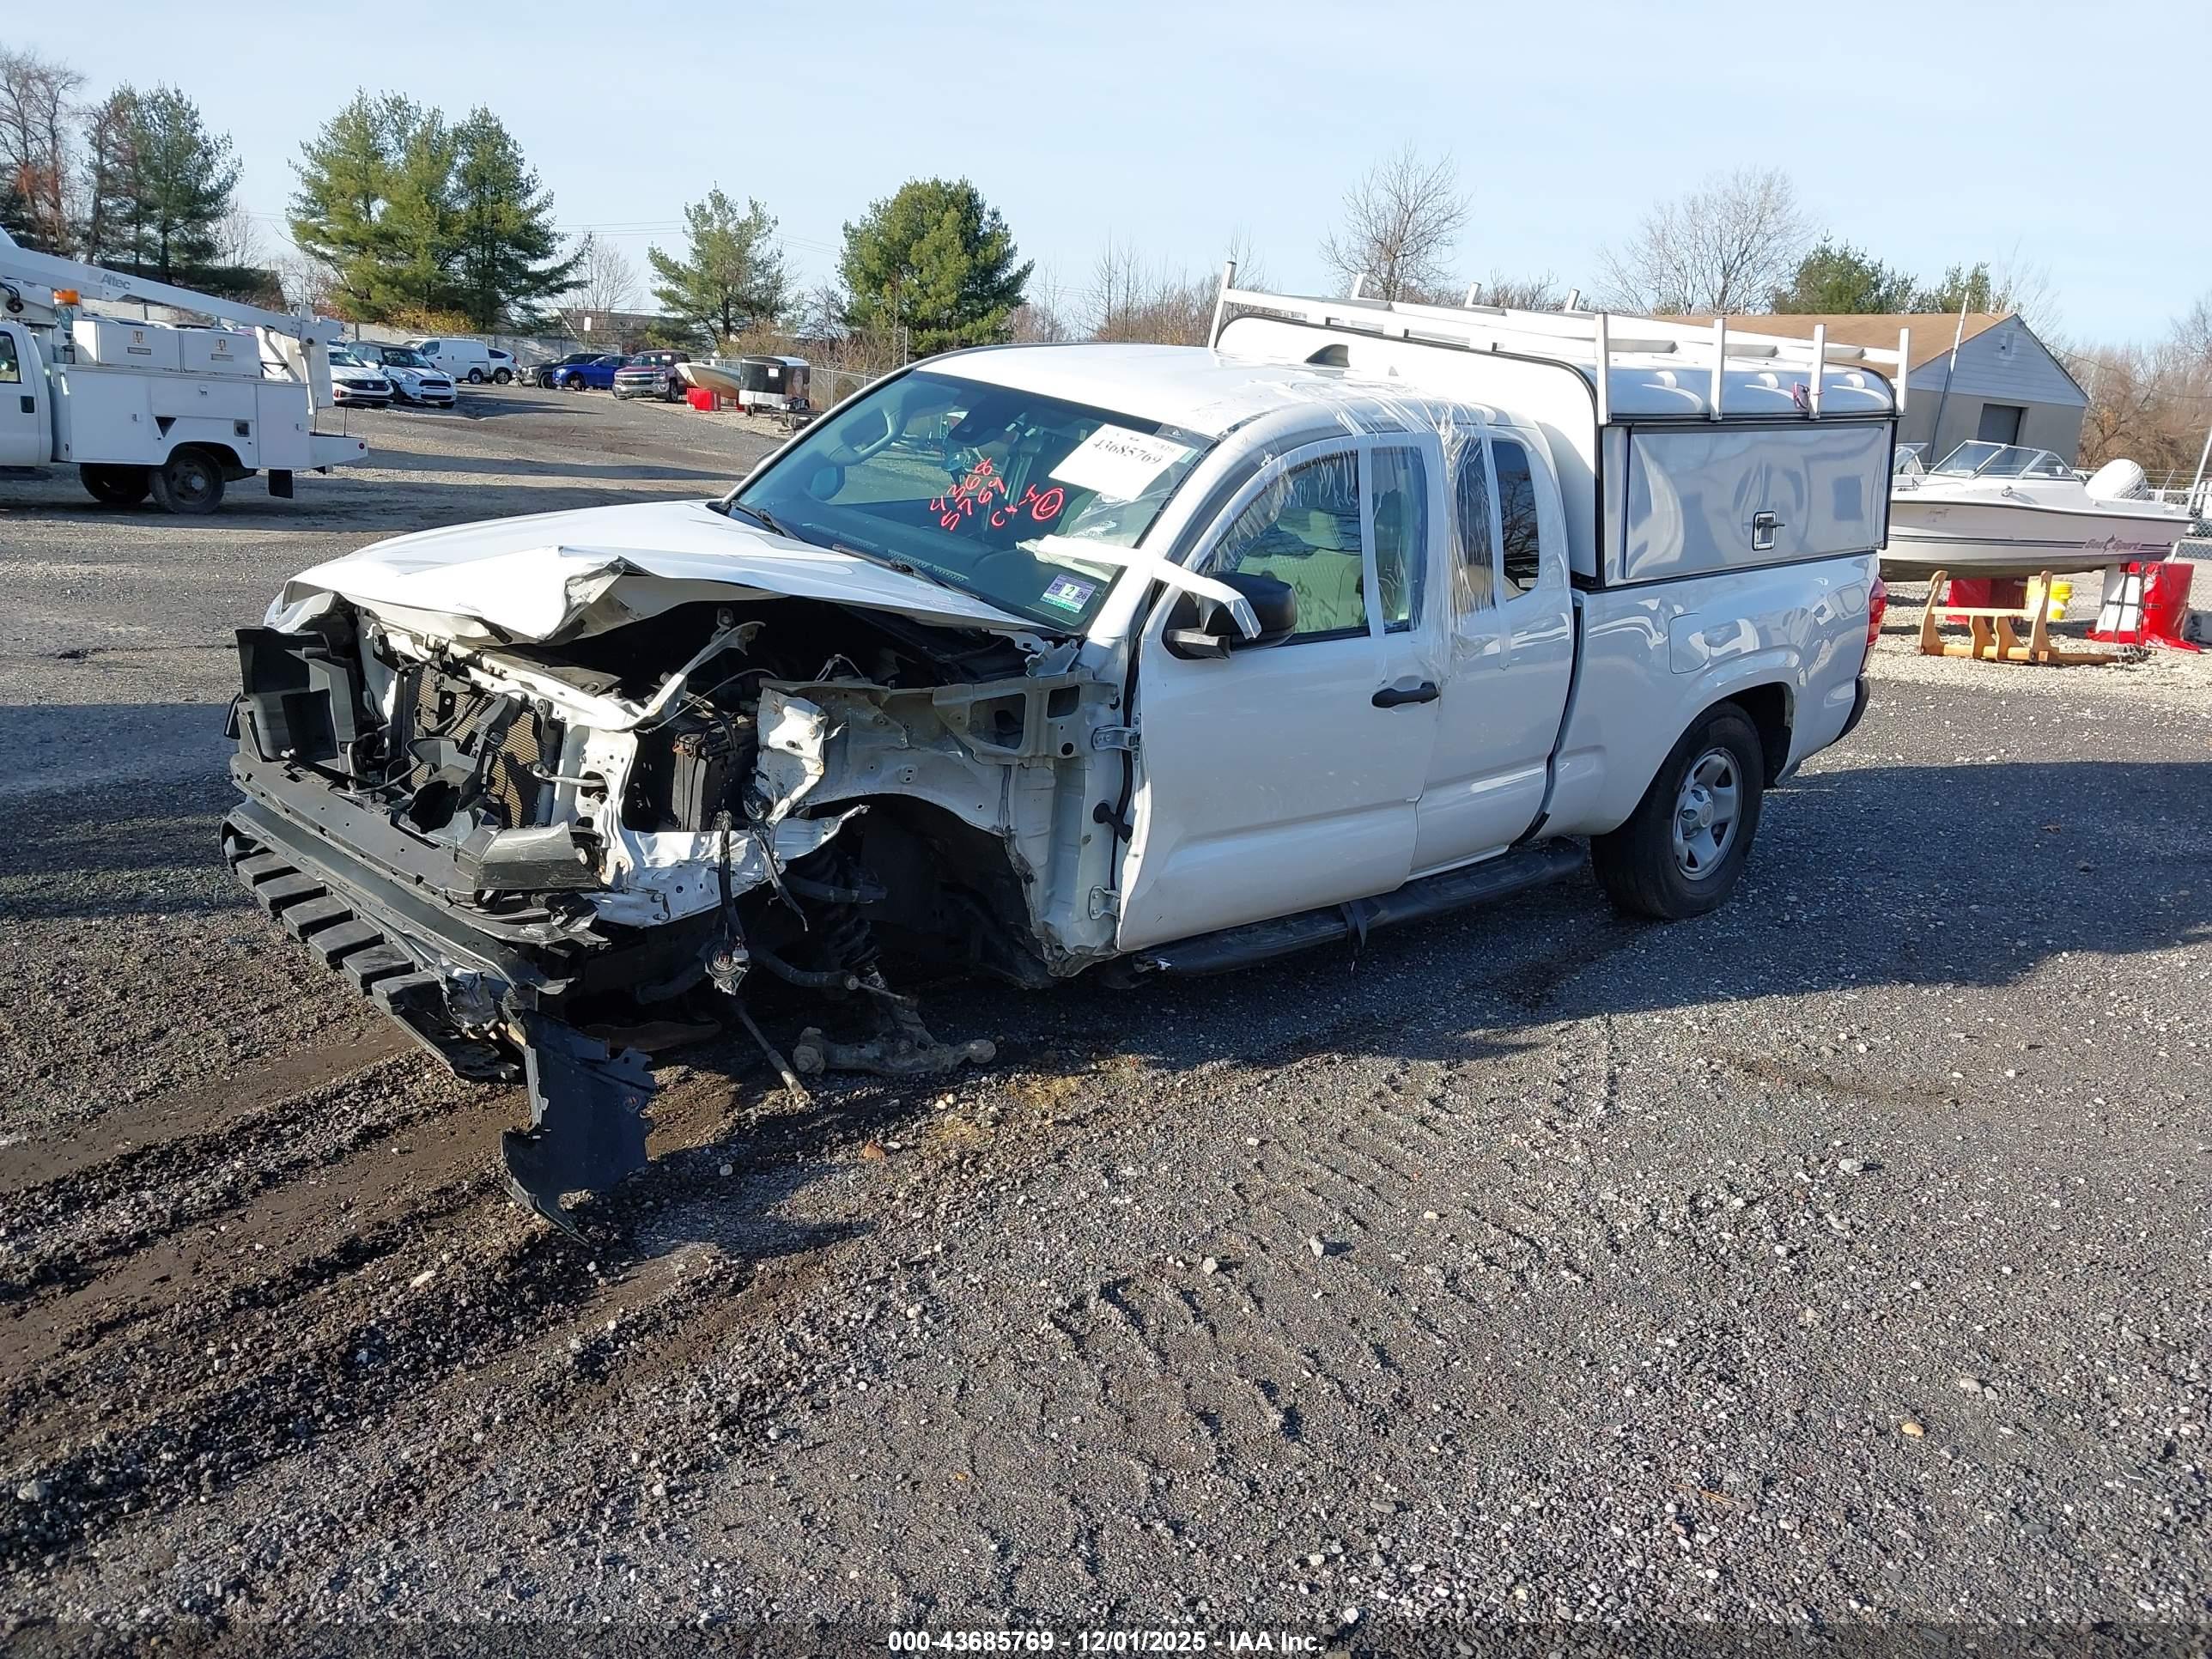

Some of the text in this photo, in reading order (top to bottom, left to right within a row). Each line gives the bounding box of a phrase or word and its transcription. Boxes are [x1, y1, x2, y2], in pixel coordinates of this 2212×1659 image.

[100, 273, 131, 290] Altec
[1093, 439, 1164, 465] 43685769
[1051, 583, 1063, 592] 20
[1065, 586, 1075, 597] 2
